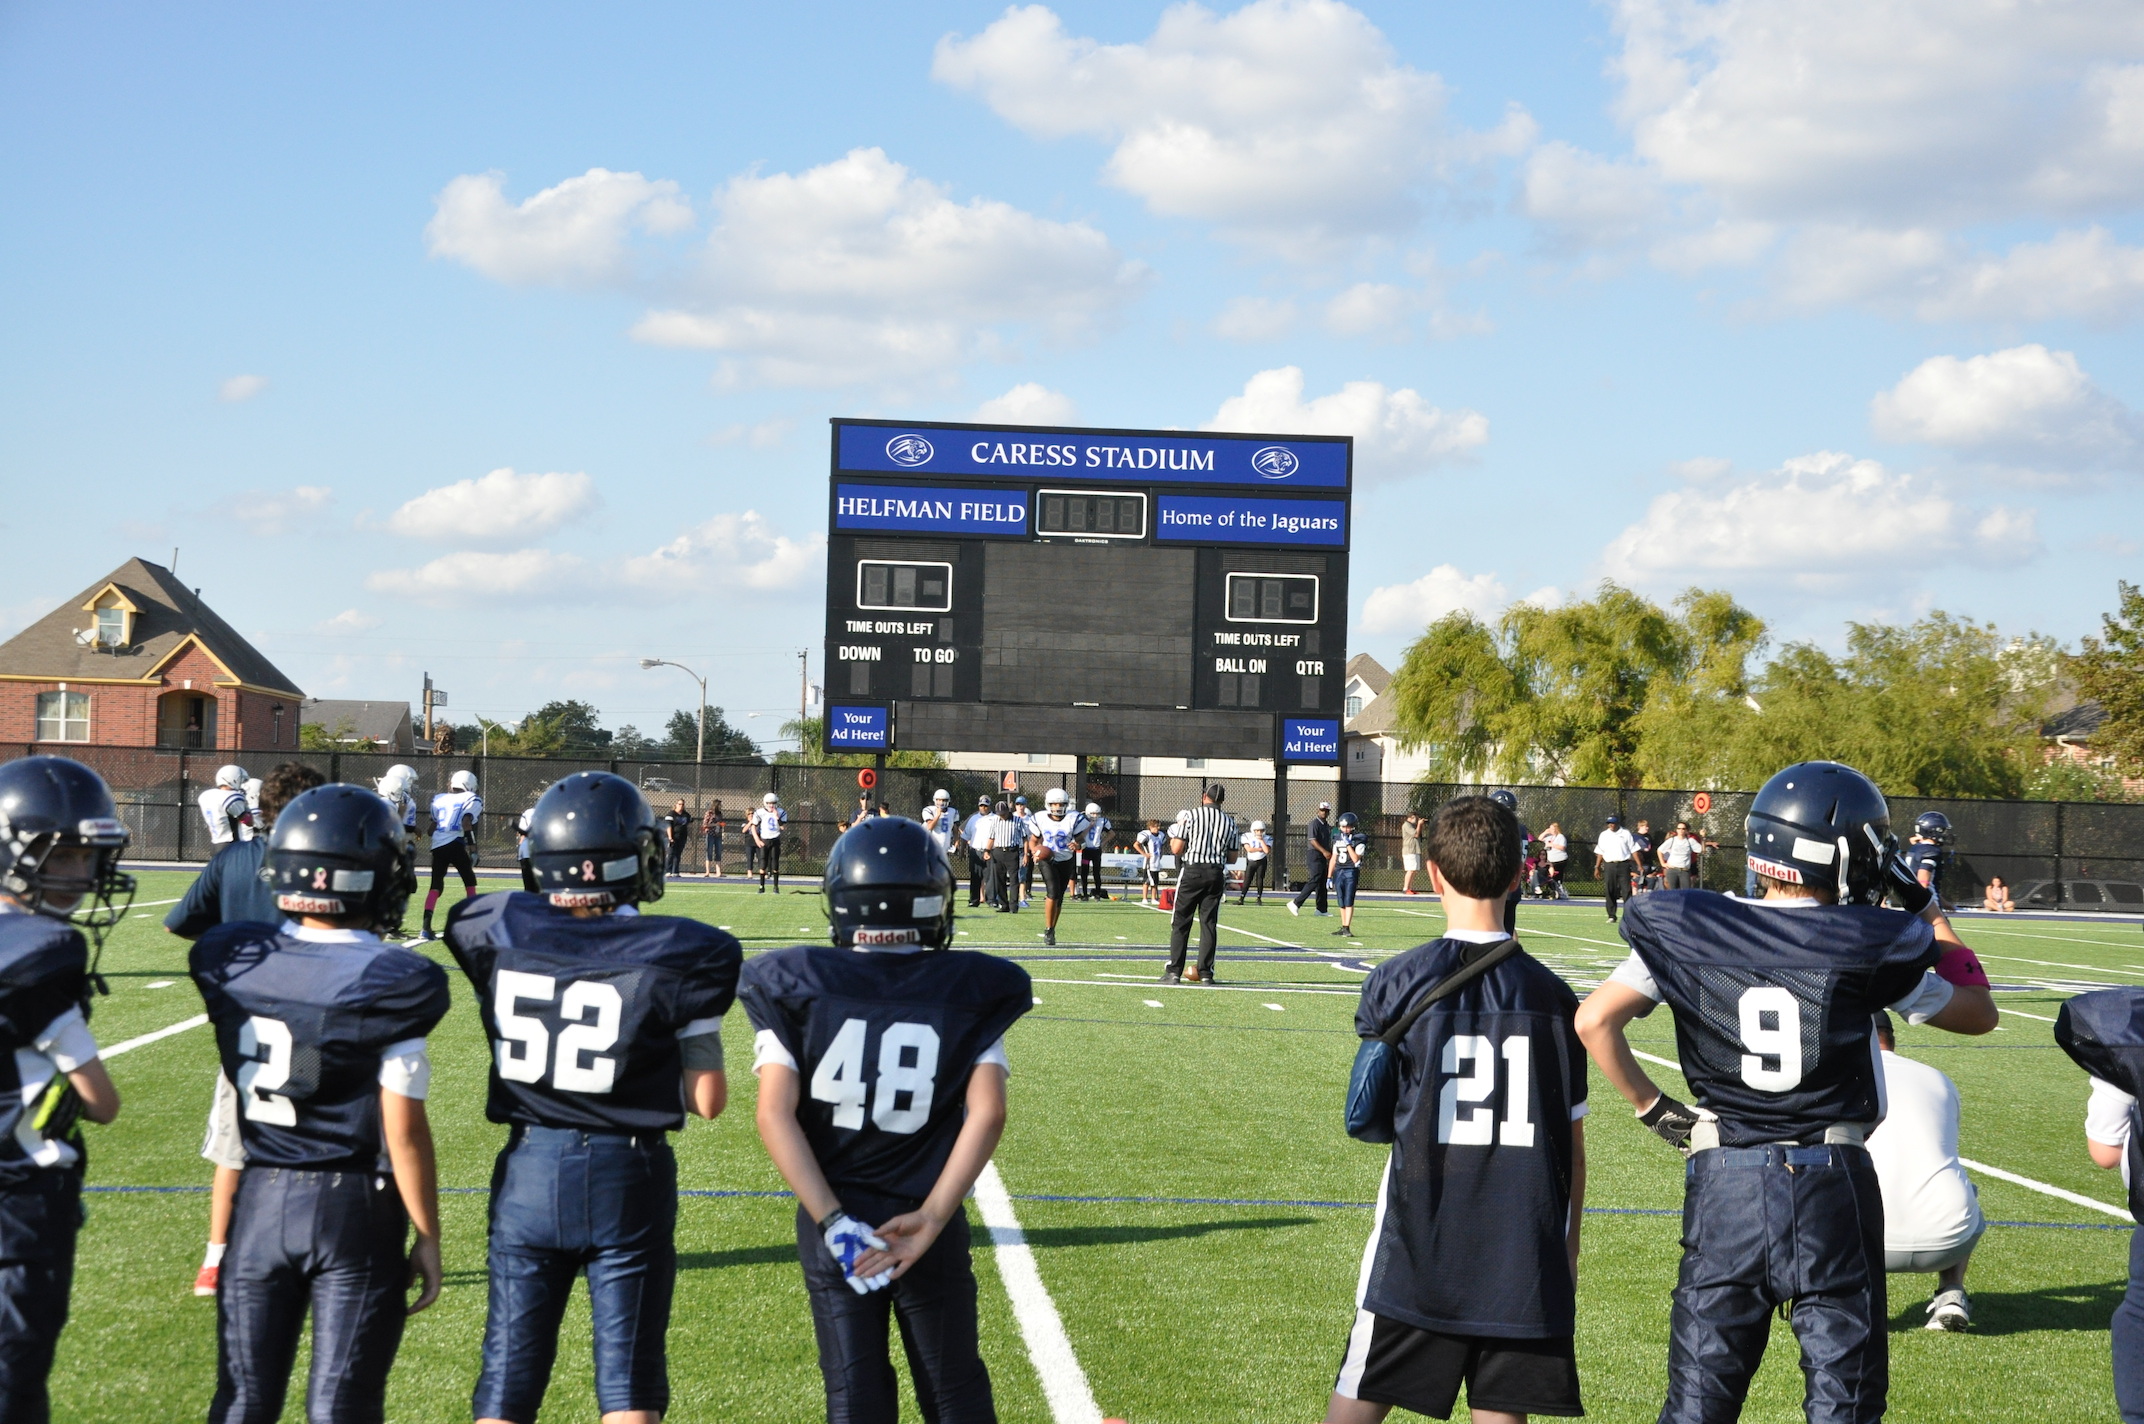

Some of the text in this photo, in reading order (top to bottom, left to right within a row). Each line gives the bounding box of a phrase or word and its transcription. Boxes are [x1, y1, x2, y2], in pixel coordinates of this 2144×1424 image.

[971, 442, 1215, 471] CARESS STADIUM
[838, 497, 1025, 523] HELFMAN FIELD
[1162, 509, 1338, 534] Home of the Jaguars
[846, 621, 933, 635] TIME OUTS LEFT
[1214, 633, 1300, 647] TIME OUTS LEFT
[839, 646, 881, 662] DOWN
[913, 648, 954, 664] TO GO
[1215, 657, 1267, 674] BALL ON
[1295, 661, 1324, 676] QTR
[843, 712, 873, 725] Your
[831, 729, 884, 742] Ad Here!
[1296, 725, 1325, 738] Your
[1284, 741, 1337, 754] Ad Here!
[1003, 771, 1017, 791] 4
[1749, 858, 1797, 882] Riddell
[282, 896, 340, 913] Riddell
[857, 930, 917, 943] Riddell
[494, 969, 623, 1094] 52
[1738, 986, 1802, 1092] 9
[237, 1015, 297, 1127] 2
[810, 1018, 940, 1135] 48
[1438, 1034, 1535, 1148] 21
